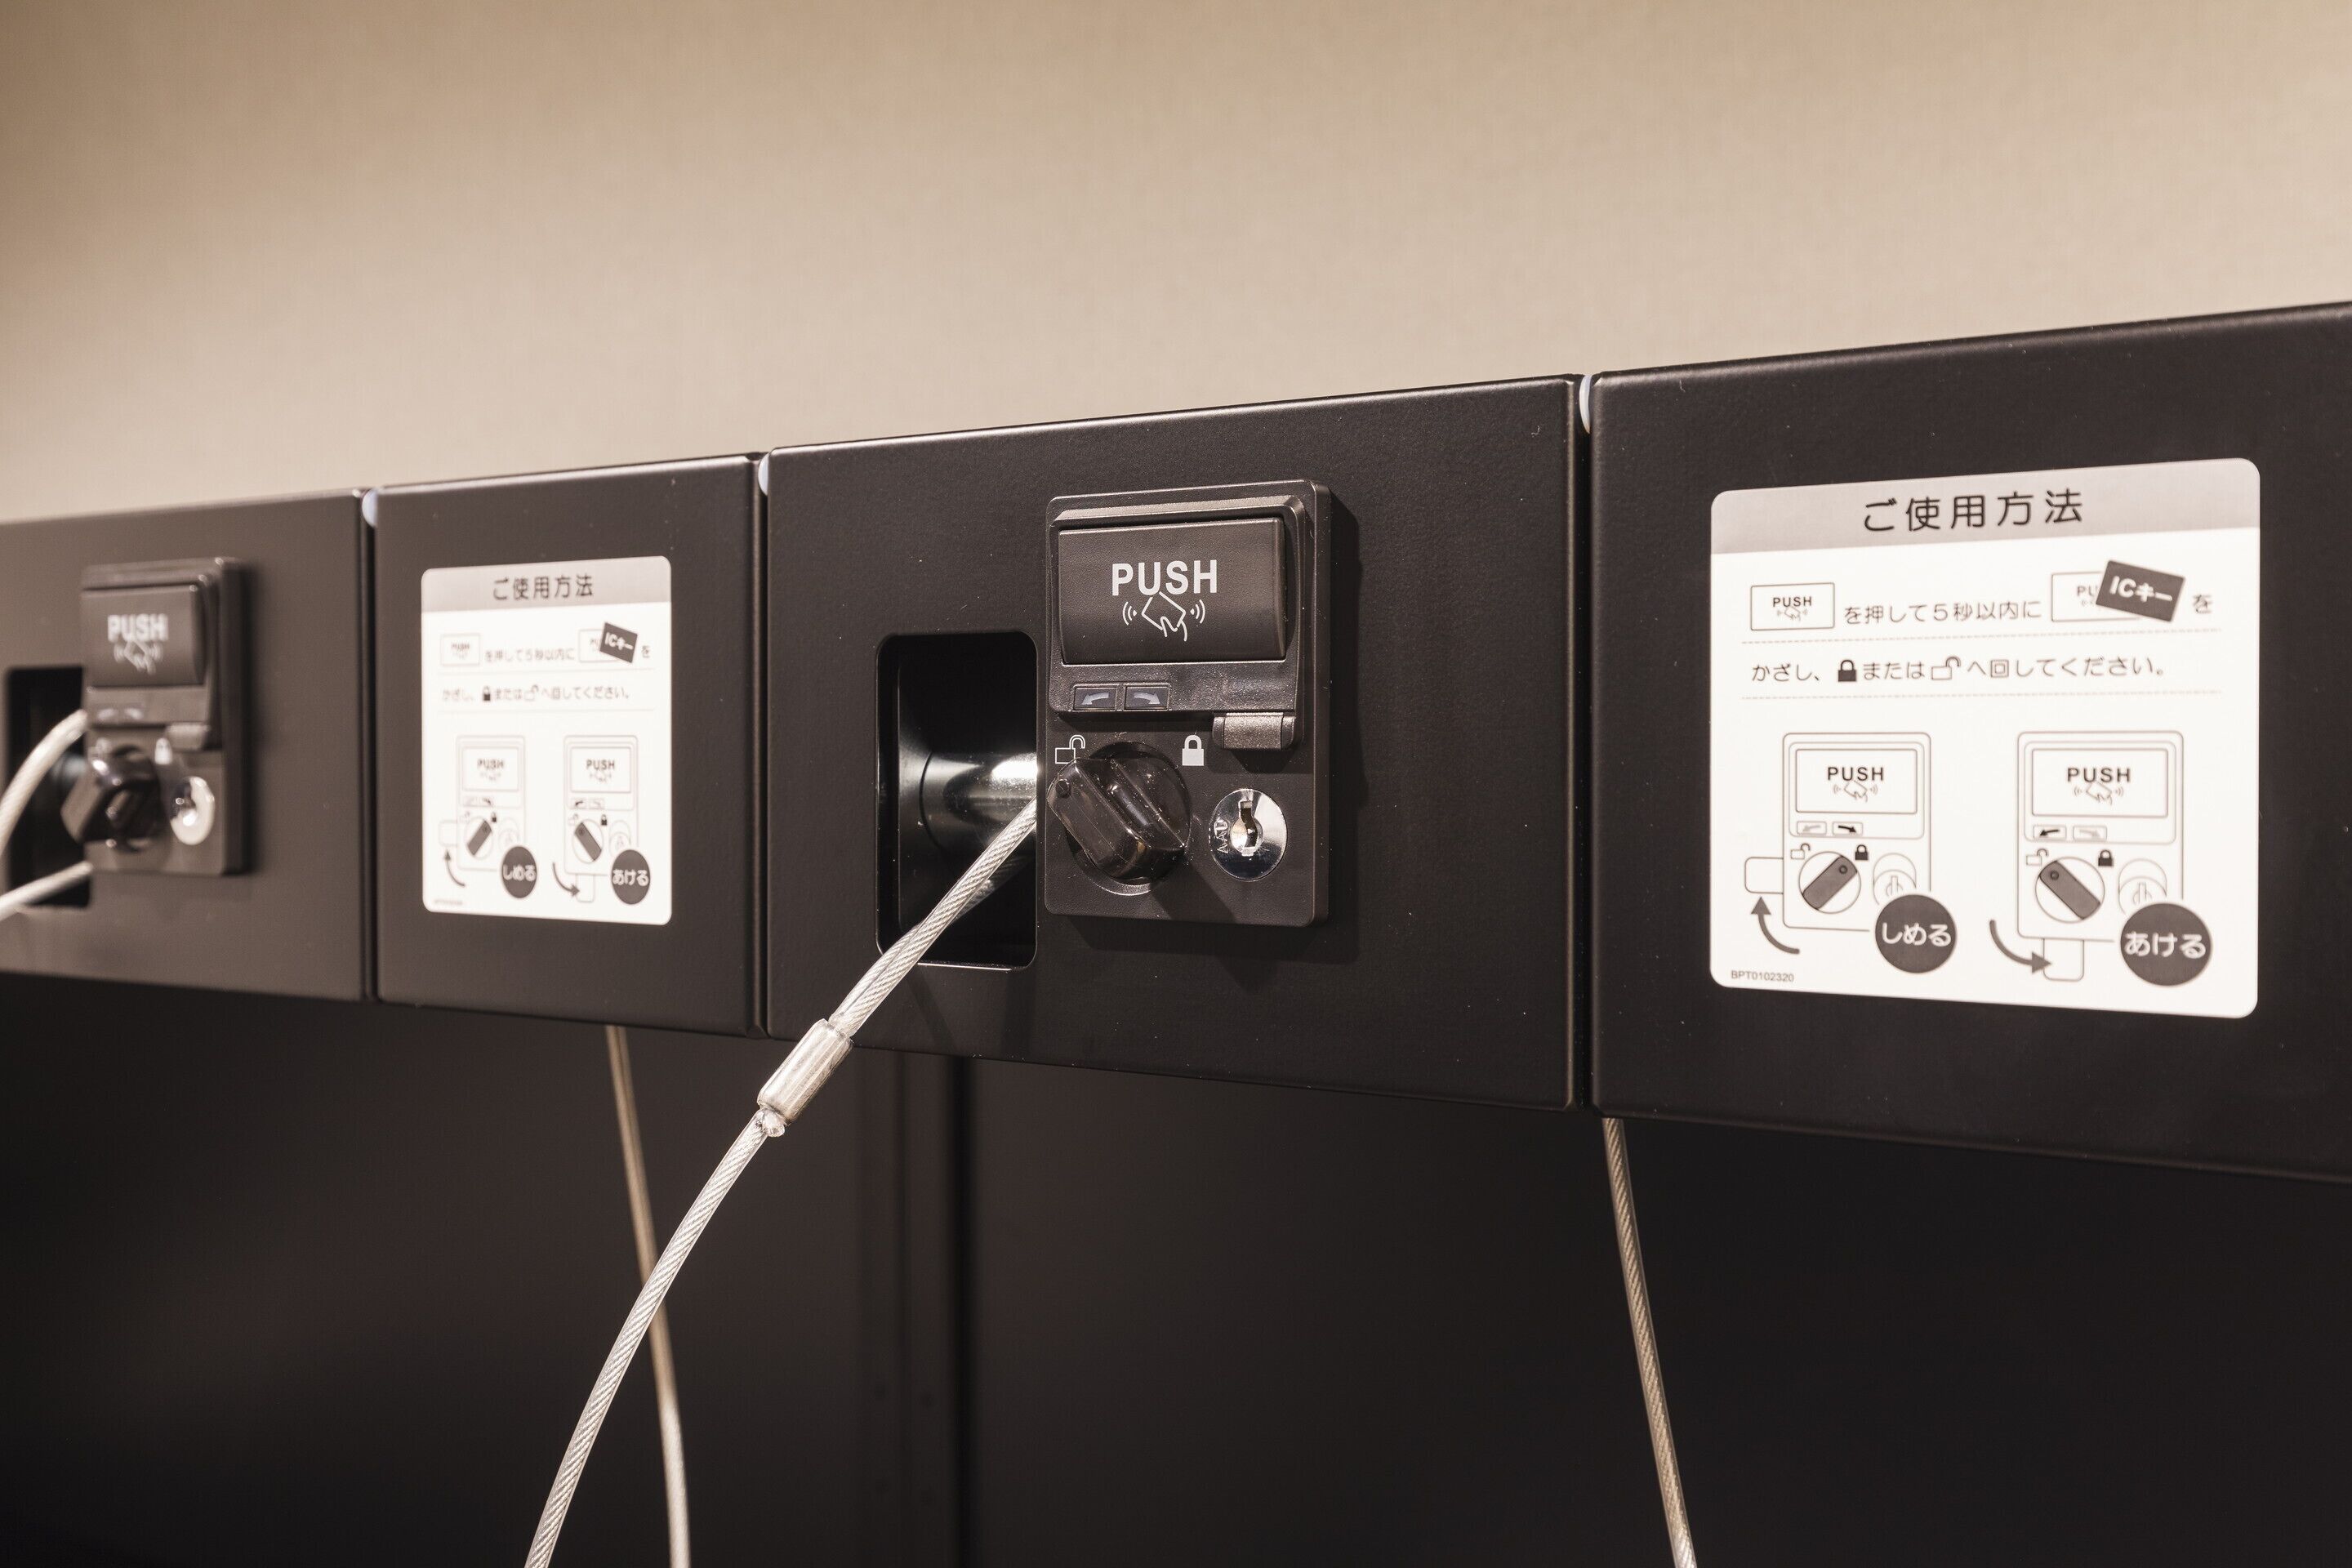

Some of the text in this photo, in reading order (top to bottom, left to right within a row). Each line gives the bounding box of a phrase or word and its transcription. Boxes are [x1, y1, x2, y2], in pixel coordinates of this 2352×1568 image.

[1863, 488, 2083, 532] ご使用方法
[492, 573, 594, 601] ご使用方法
[1111, 559, 1218, 596] PUSH
[1772, 596, 1813, 608] PUSH
[2109, 574, 2173, 603] ICキー
[2192, 594, 2213, 614] を
[108, 613, 168, 643] PUSH
[1863, 660, 1925, 680] または
[1967, 655, 2165, 679] へ回してください。
[477, 758, 505, 769] PUSH
[586, 759, 616, 771] PUSH
[1827, 766, 1885, 782] PUSH
[2067, 767, 2132, 783] PUSH
[502, 864, 536, 882] しめる
[612, 868, 650, 887] あける
[1882, 922, 1952, 948] しめる
[2124, 930, 2207, 958] あける
[1731, 969, 1795, 983] BPT0102320
